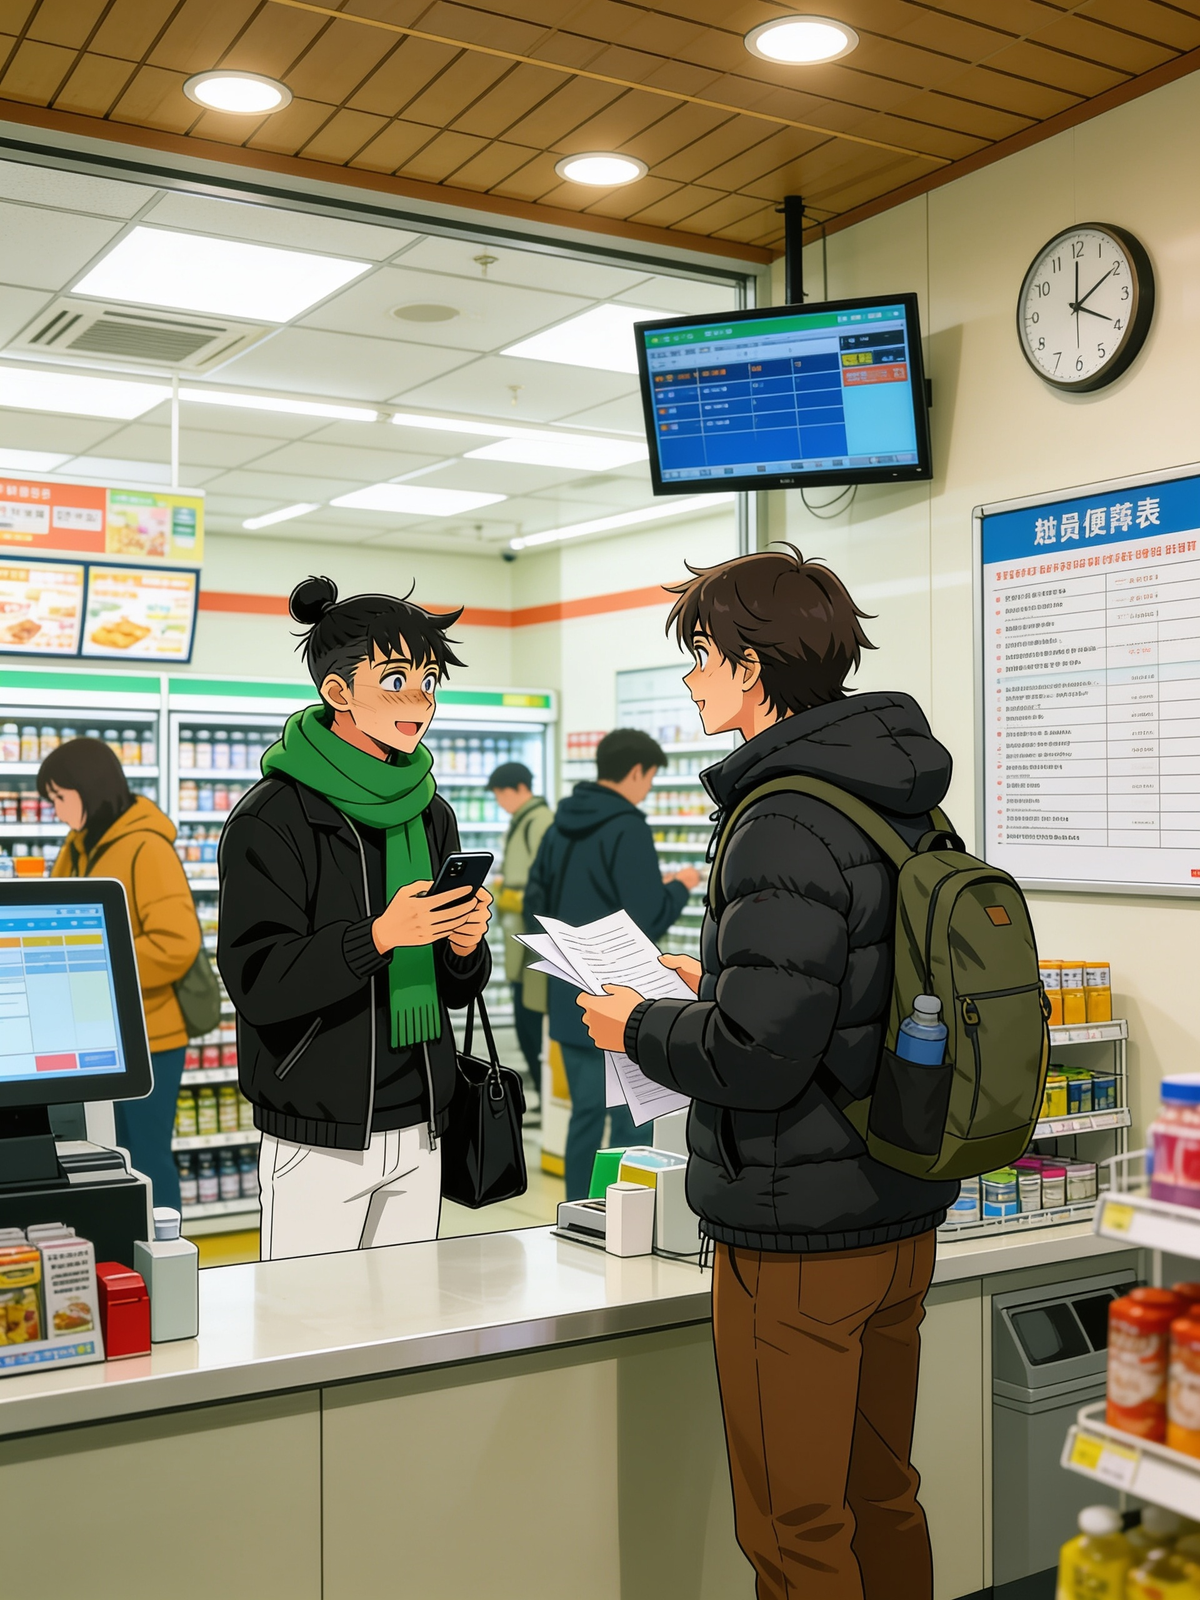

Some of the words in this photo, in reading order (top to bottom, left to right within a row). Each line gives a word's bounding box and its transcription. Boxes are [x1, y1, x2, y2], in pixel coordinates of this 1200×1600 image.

[1072, 241, 1084, 259] 12
[1098, 243, 1102, 258] 1
[1052, 257, 1061, 273] 11
[1112, 260, 1121, 276] 2
[1035, 281, 1050, 298] 10
[1121, 286, 1129, 301] 3
[1113, 319, 1123, 330] 4
[1038, 337, 1045, 350] 8
[1097, 343, 1106, 359] 5
[1053, 351, 1063, 375] 7
[1075, 355, 1084, 372] 6
